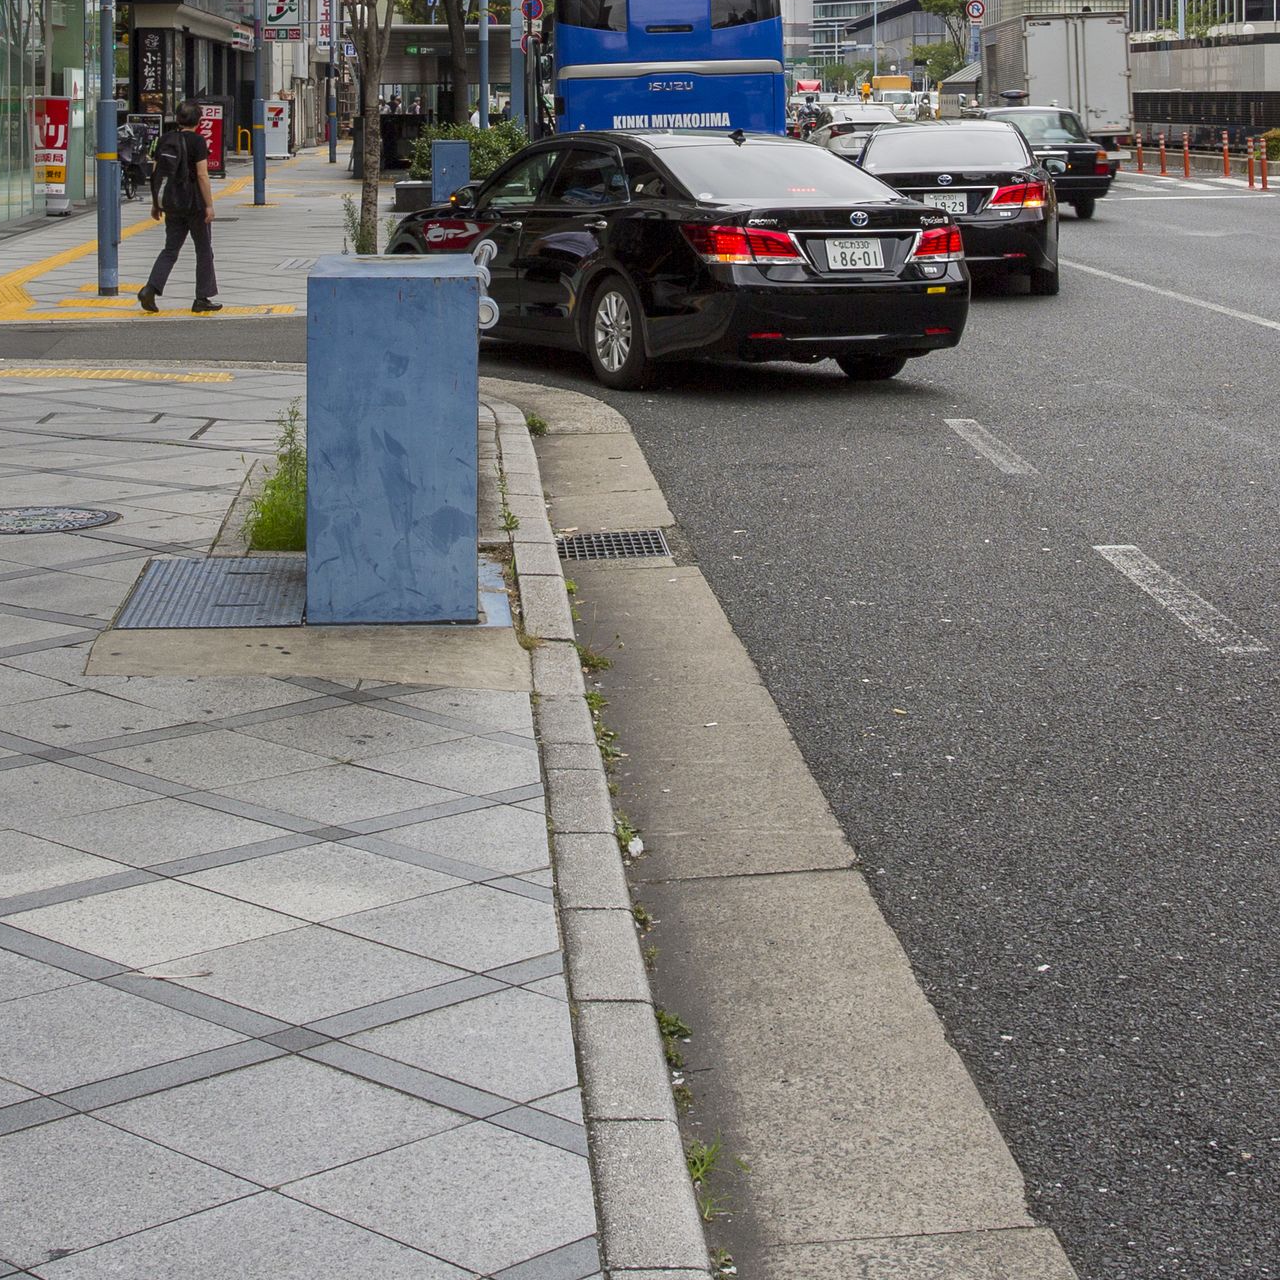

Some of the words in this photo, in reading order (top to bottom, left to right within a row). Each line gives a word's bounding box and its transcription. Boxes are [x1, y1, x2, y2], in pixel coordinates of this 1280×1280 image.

[143, 52, 157, 91] 小松屋
[648, 81, 694, 91] ISUZU
[206, 107, 220, 117] 2F
[613, 115, 649, 129] KINKI
[651, 112, 731, 128] MIYAKOJIMA
[748, 218, 779, 226] CROWN
[840, 251, 879, 267] 86-01
